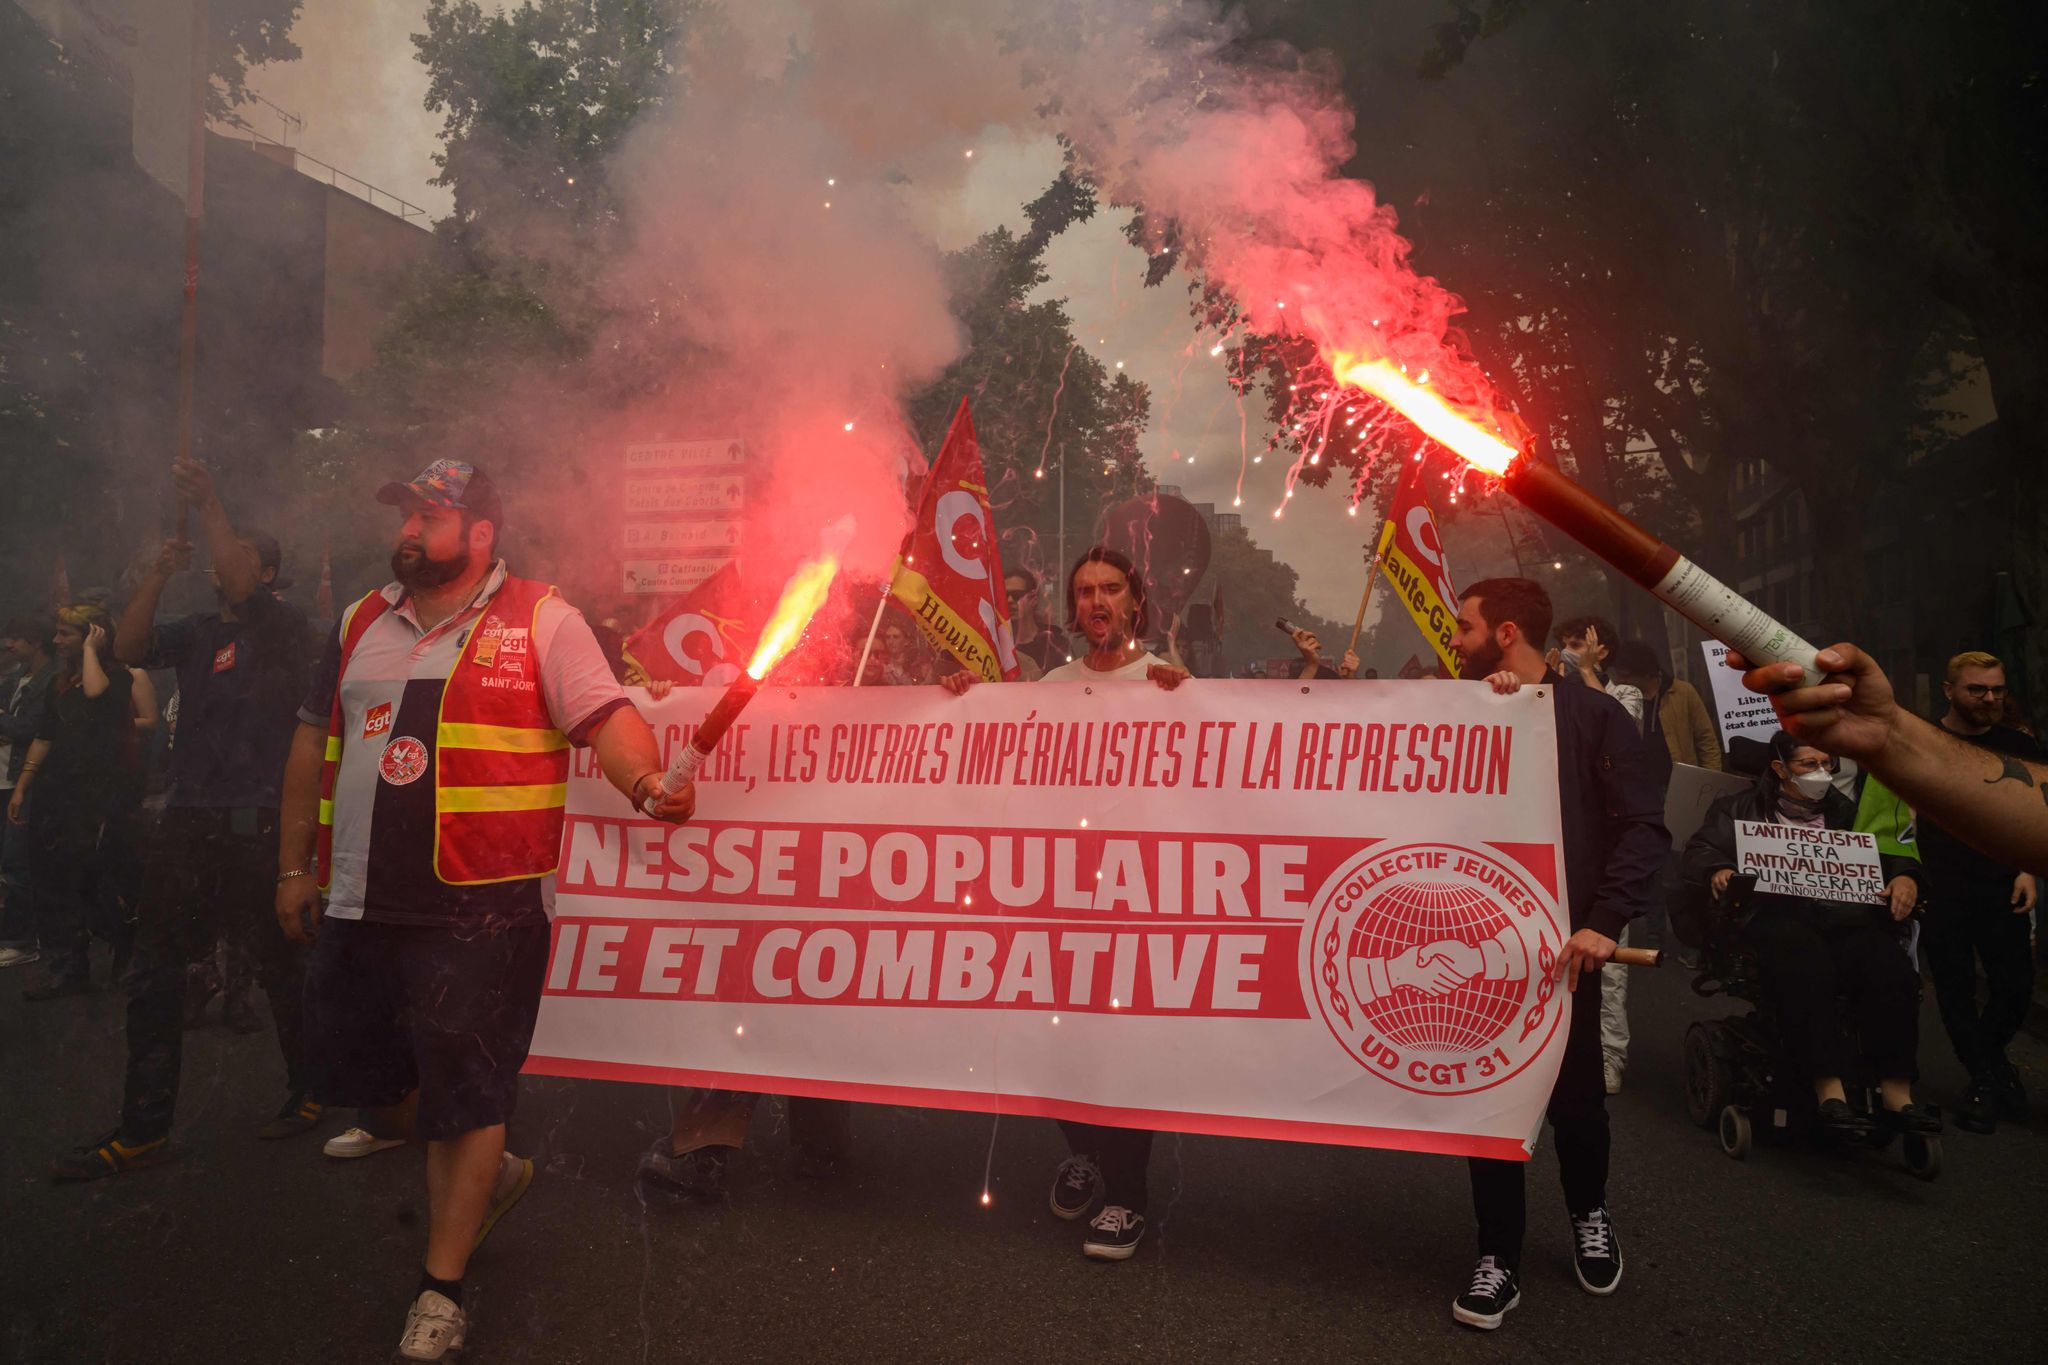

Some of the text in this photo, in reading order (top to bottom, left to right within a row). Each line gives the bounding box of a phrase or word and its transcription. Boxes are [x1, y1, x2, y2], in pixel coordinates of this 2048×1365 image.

[501, 635, 527, 651] cgt
[1711, 648, 1731, 657] Blo
[481, 676, 537, 692] SAINT JORY
[1737, 695, 1768, 706] Liber
[365, 710, 391, 732] cgt
[1724, 707, 1777, 720] d'express
[1725, 716, 1780, 731] état de néce
[767, 723, 821, 784] LES
[826, 721, 951, 785] GUERRES
[957, 710, 1187, 788] IMPÉRIALISTES
[1192, 720, 1237, 790] ET
[1240, 721, 1282, 790] LA
[1293, 721, 1513, 796] REPRESSION
[1742, 822, 1874, 849] L'ANTIFASCISME
[1786, 842, 1840, 861] SERA
[562, 821, 1310, 921] NESSE POPULAIRE
[1334, 851, 1537, 919] COLLECTIF JEUNES
[1776, 871, 1804, 886] NE
[1805, 873, 1853, 891] SERA
[1857, 878, 1885, 895] PAS
[547, 923, 1268, 1011] IE ET COMBATIVE
[1360, 1033, 1512, 1086] UD CGT 31
